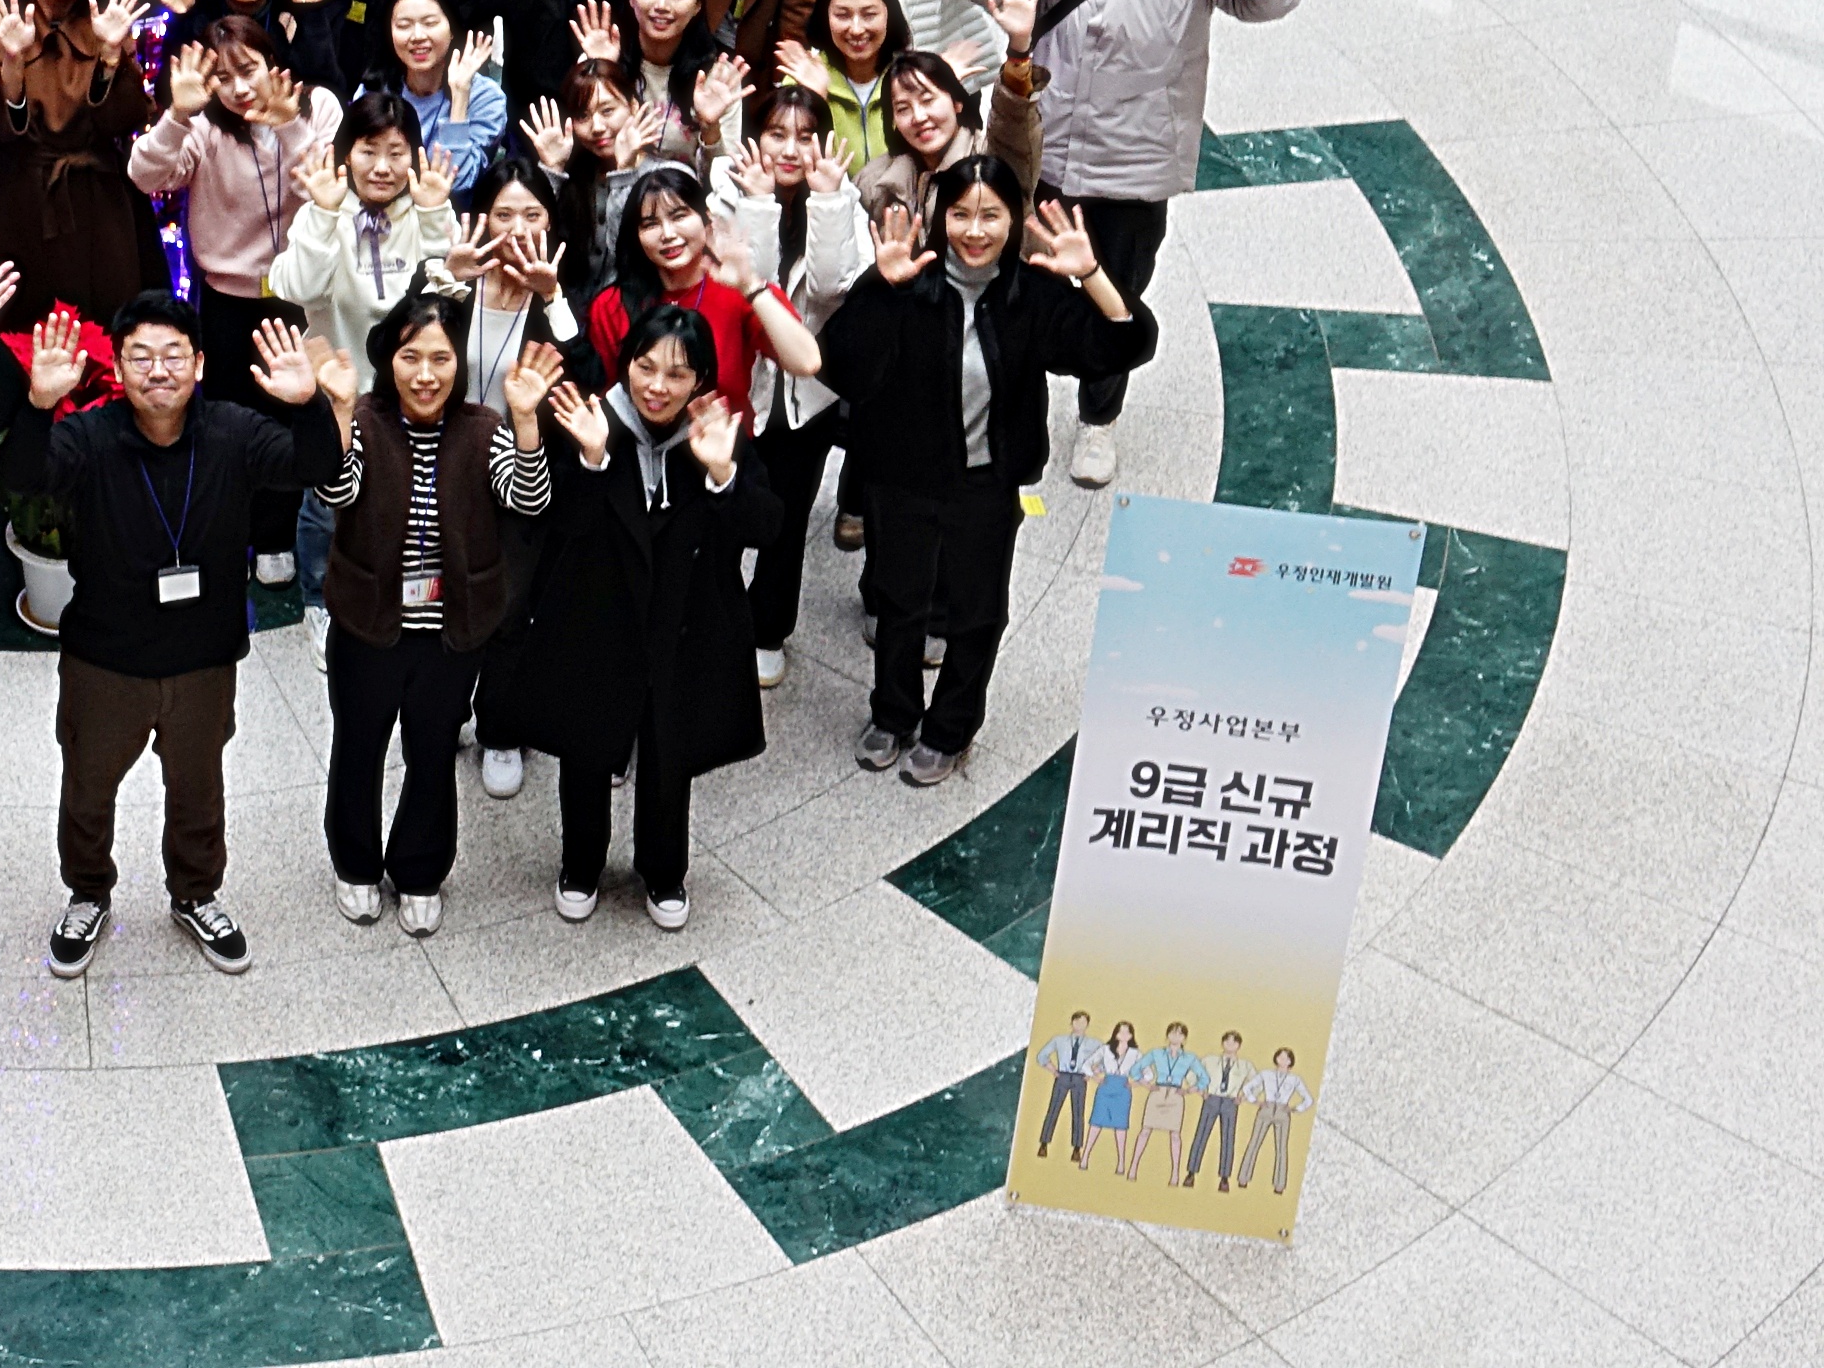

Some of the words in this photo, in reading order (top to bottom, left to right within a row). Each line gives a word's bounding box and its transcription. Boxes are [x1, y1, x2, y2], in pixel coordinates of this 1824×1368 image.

[1276, 562, 1392, 590] 우정인재개발원
[1146, 705, 1301, 743] 우정사업본부
[1129, 760, 1207, 809] 9급
[1220, 770, 1315, 820] 신규
[1088, 806, 1233, 862] 계리직
[1239, 823, 1339, 877] 과정
